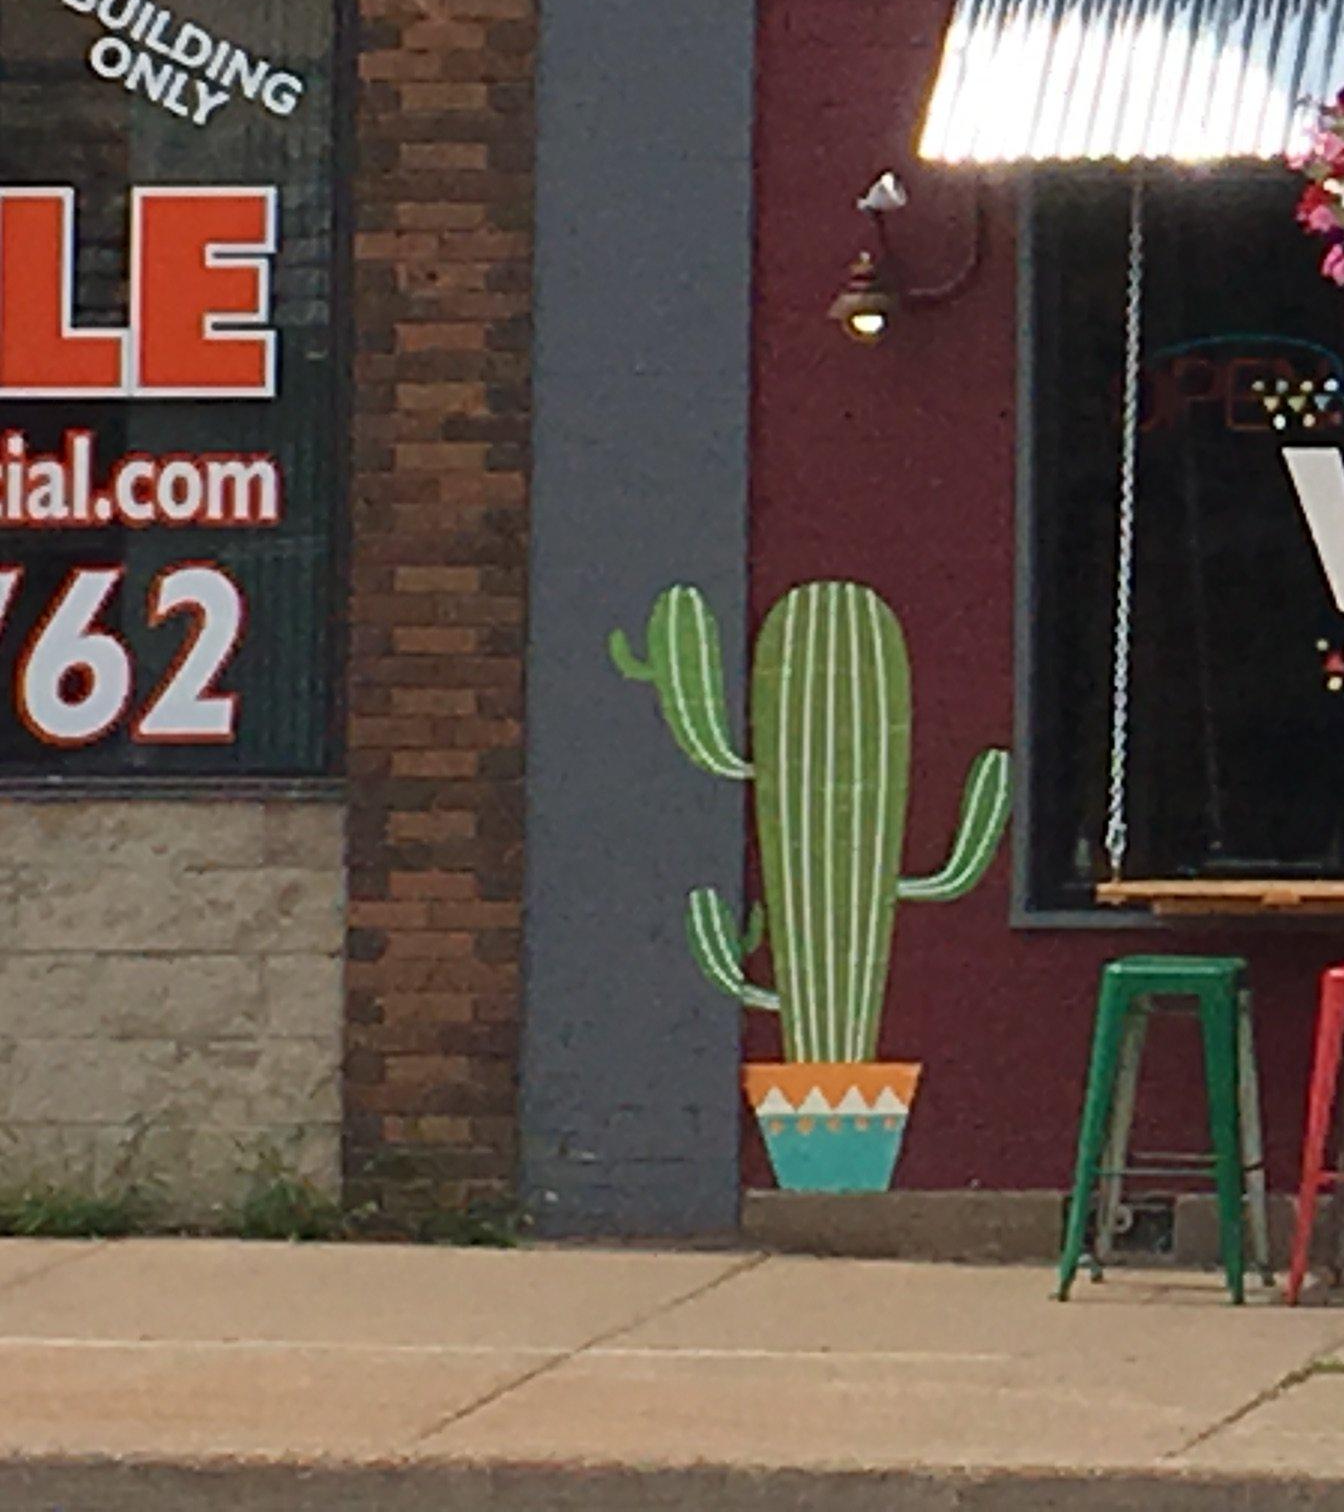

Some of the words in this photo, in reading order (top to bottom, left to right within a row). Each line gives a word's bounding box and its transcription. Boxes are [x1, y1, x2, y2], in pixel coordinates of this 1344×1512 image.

[90, 37, 230, 126] ONLY
[0, 431, 280, 524] ial.com
[0, 564, 244, 744] 62
